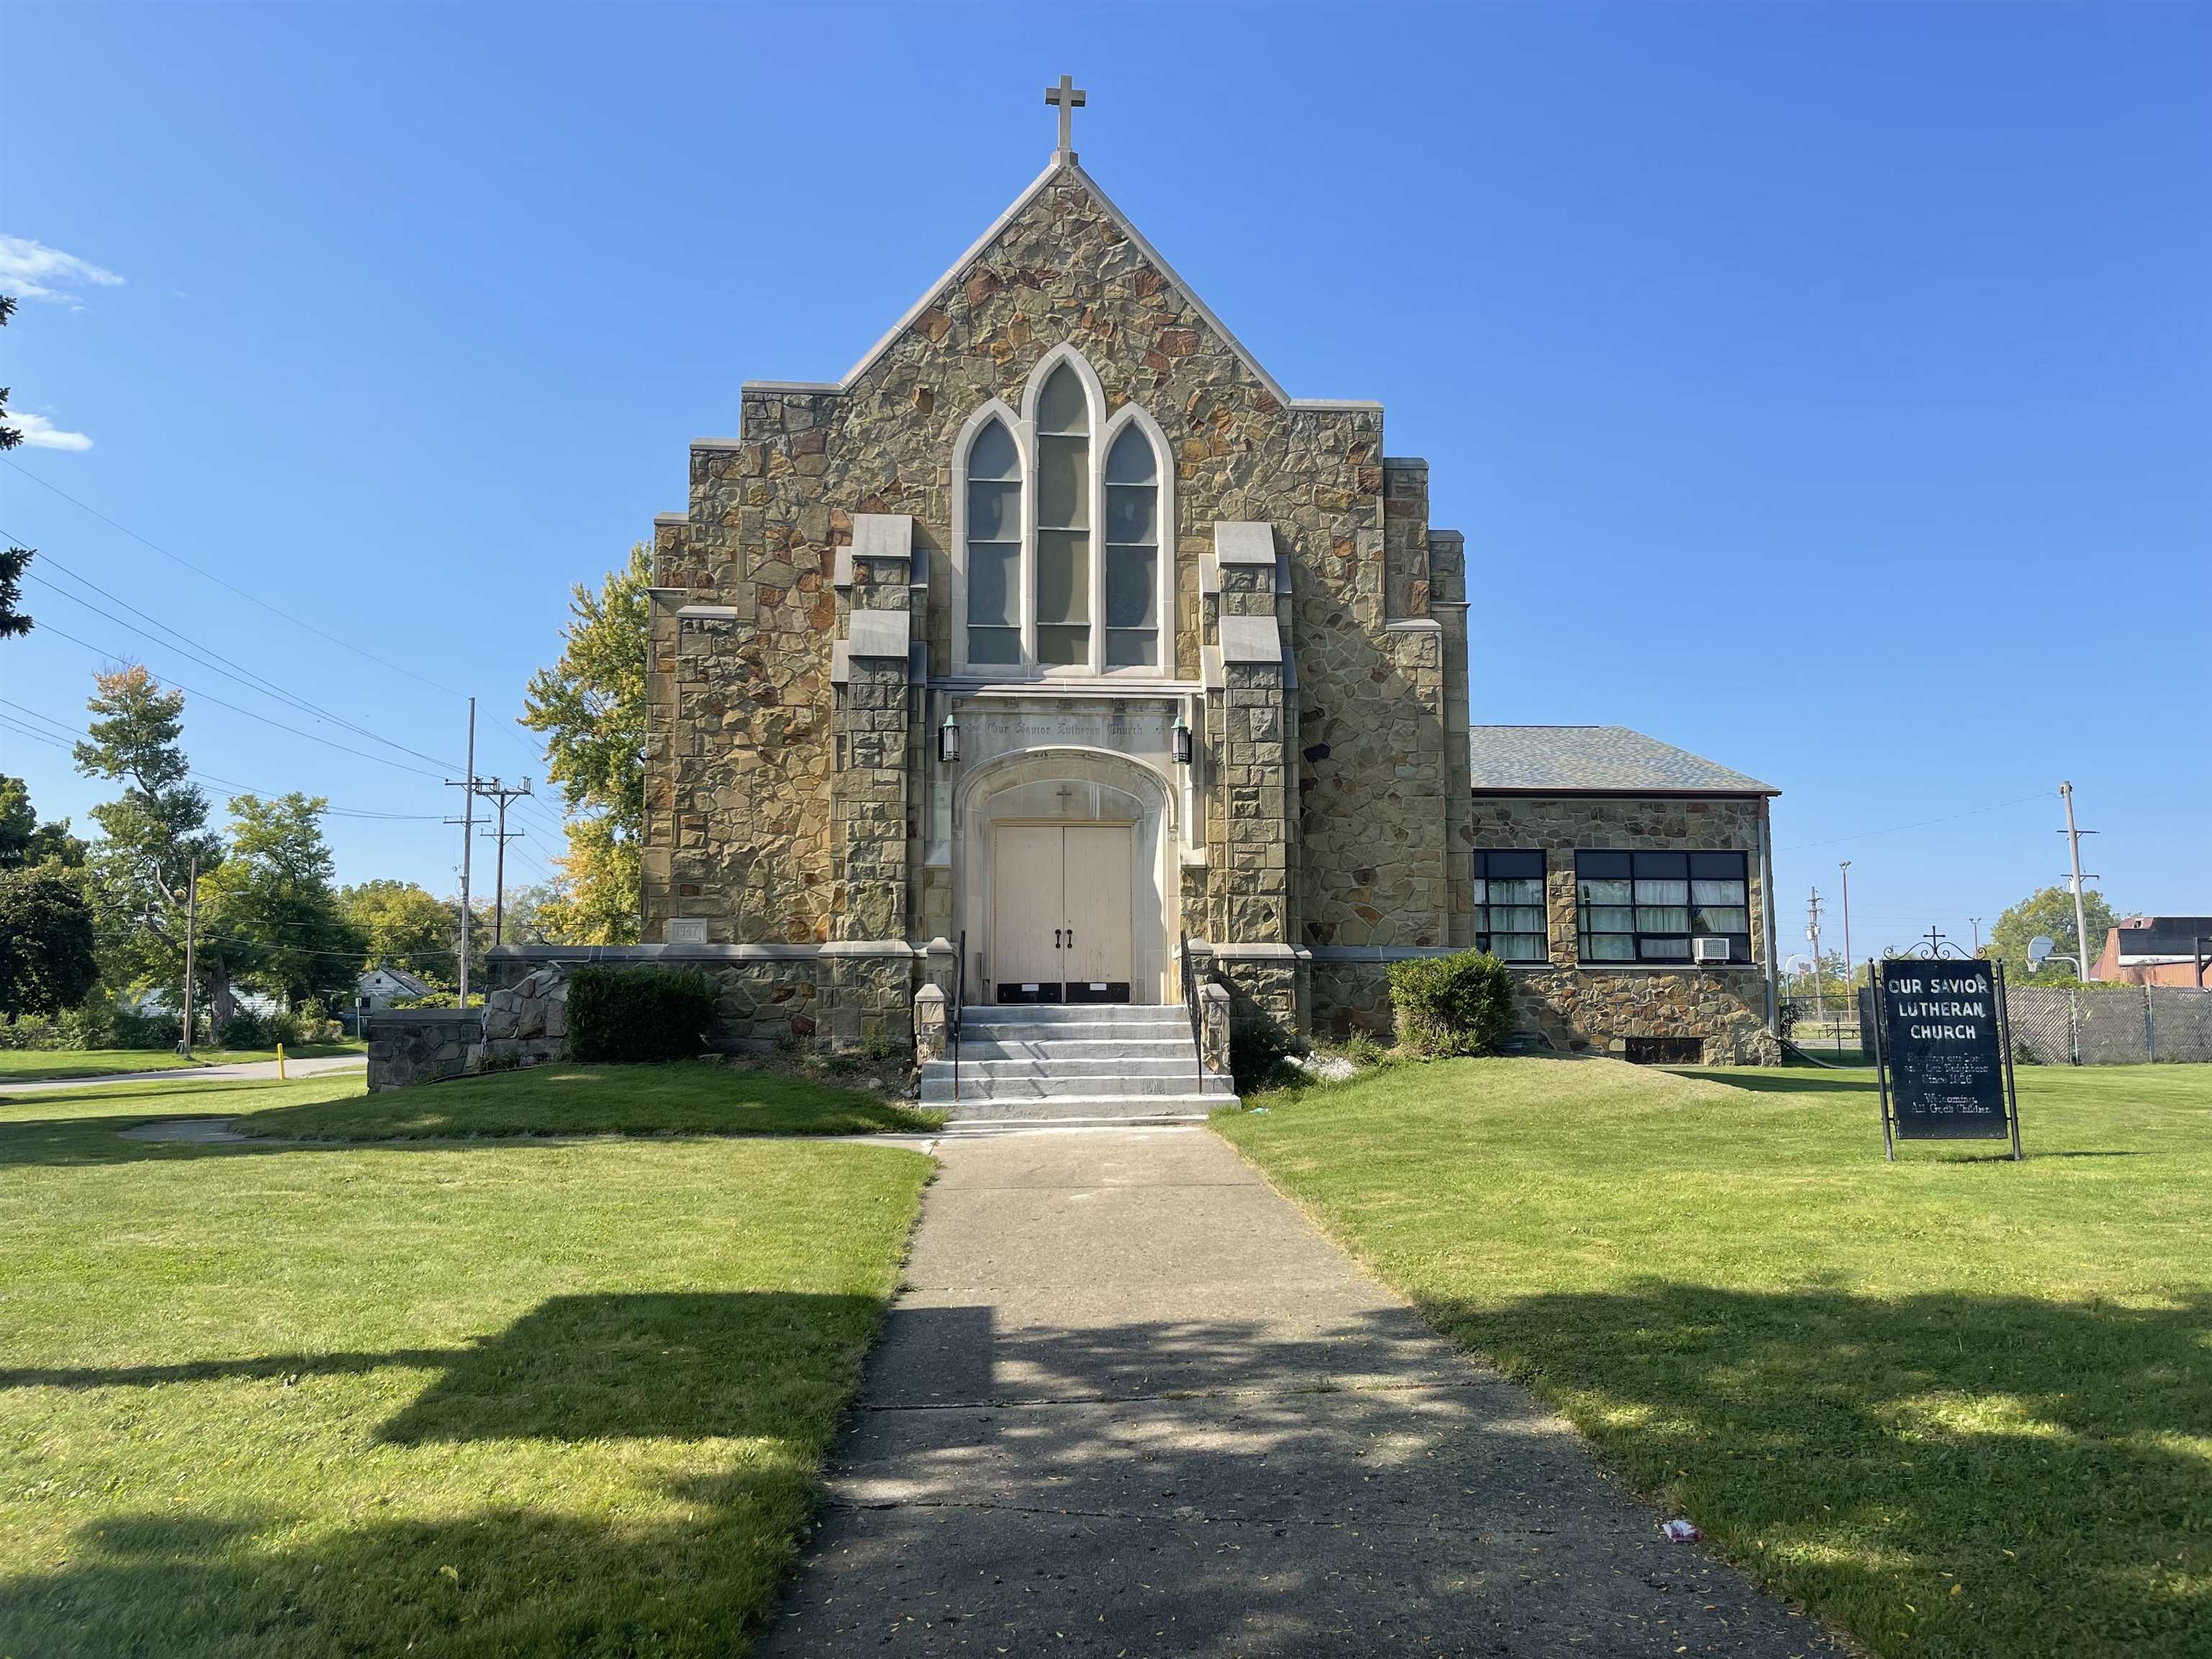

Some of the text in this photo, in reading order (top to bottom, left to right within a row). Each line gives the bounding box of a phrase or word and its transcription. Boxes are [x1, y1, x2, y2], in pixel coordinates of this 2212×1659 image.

[1888, 978, 1991, 994] OUR SAVIOR
[1898, 1002, 1986, 1018] LUTHERAN
[1910, 1024, 1976, 1040] CHURCH
